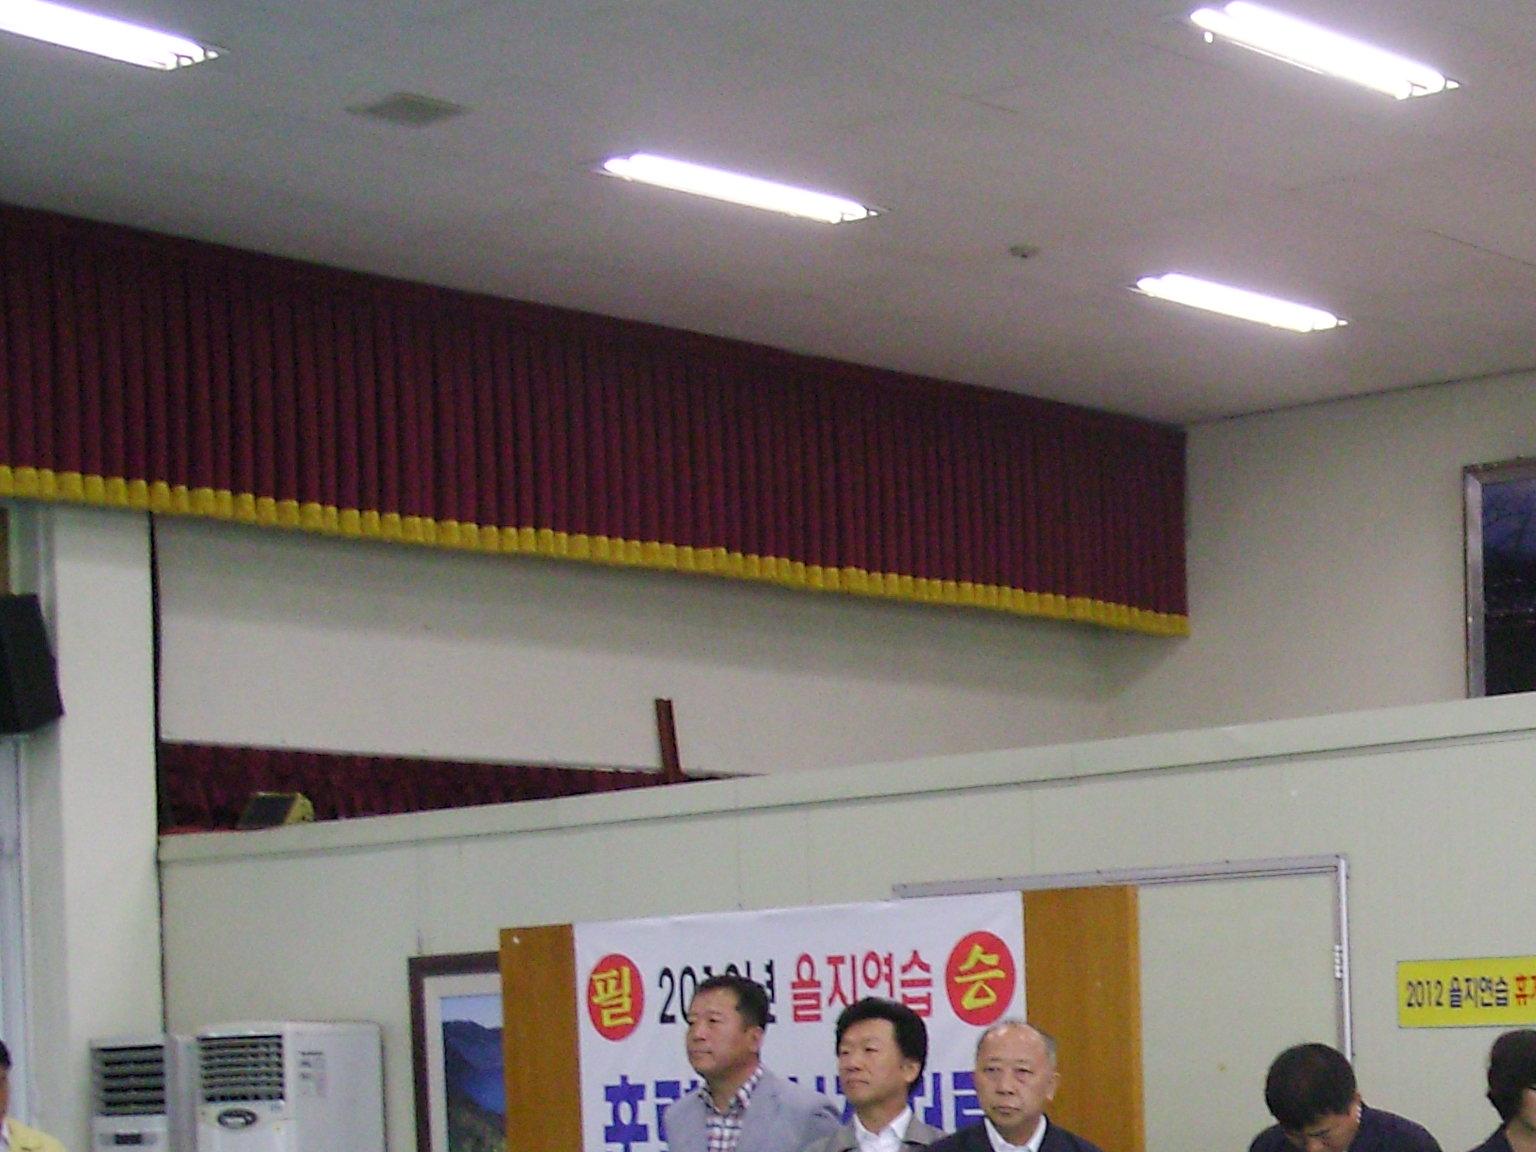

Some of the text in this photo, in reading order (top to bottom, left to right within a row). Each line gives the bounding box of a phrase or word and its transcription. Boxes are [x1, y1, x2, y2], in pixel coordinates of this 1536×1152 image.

[590, 966, 633, 1026] 필
[953, 943, 1006, 1011] 승
[1406, 979, 1444, 1008] 2012
